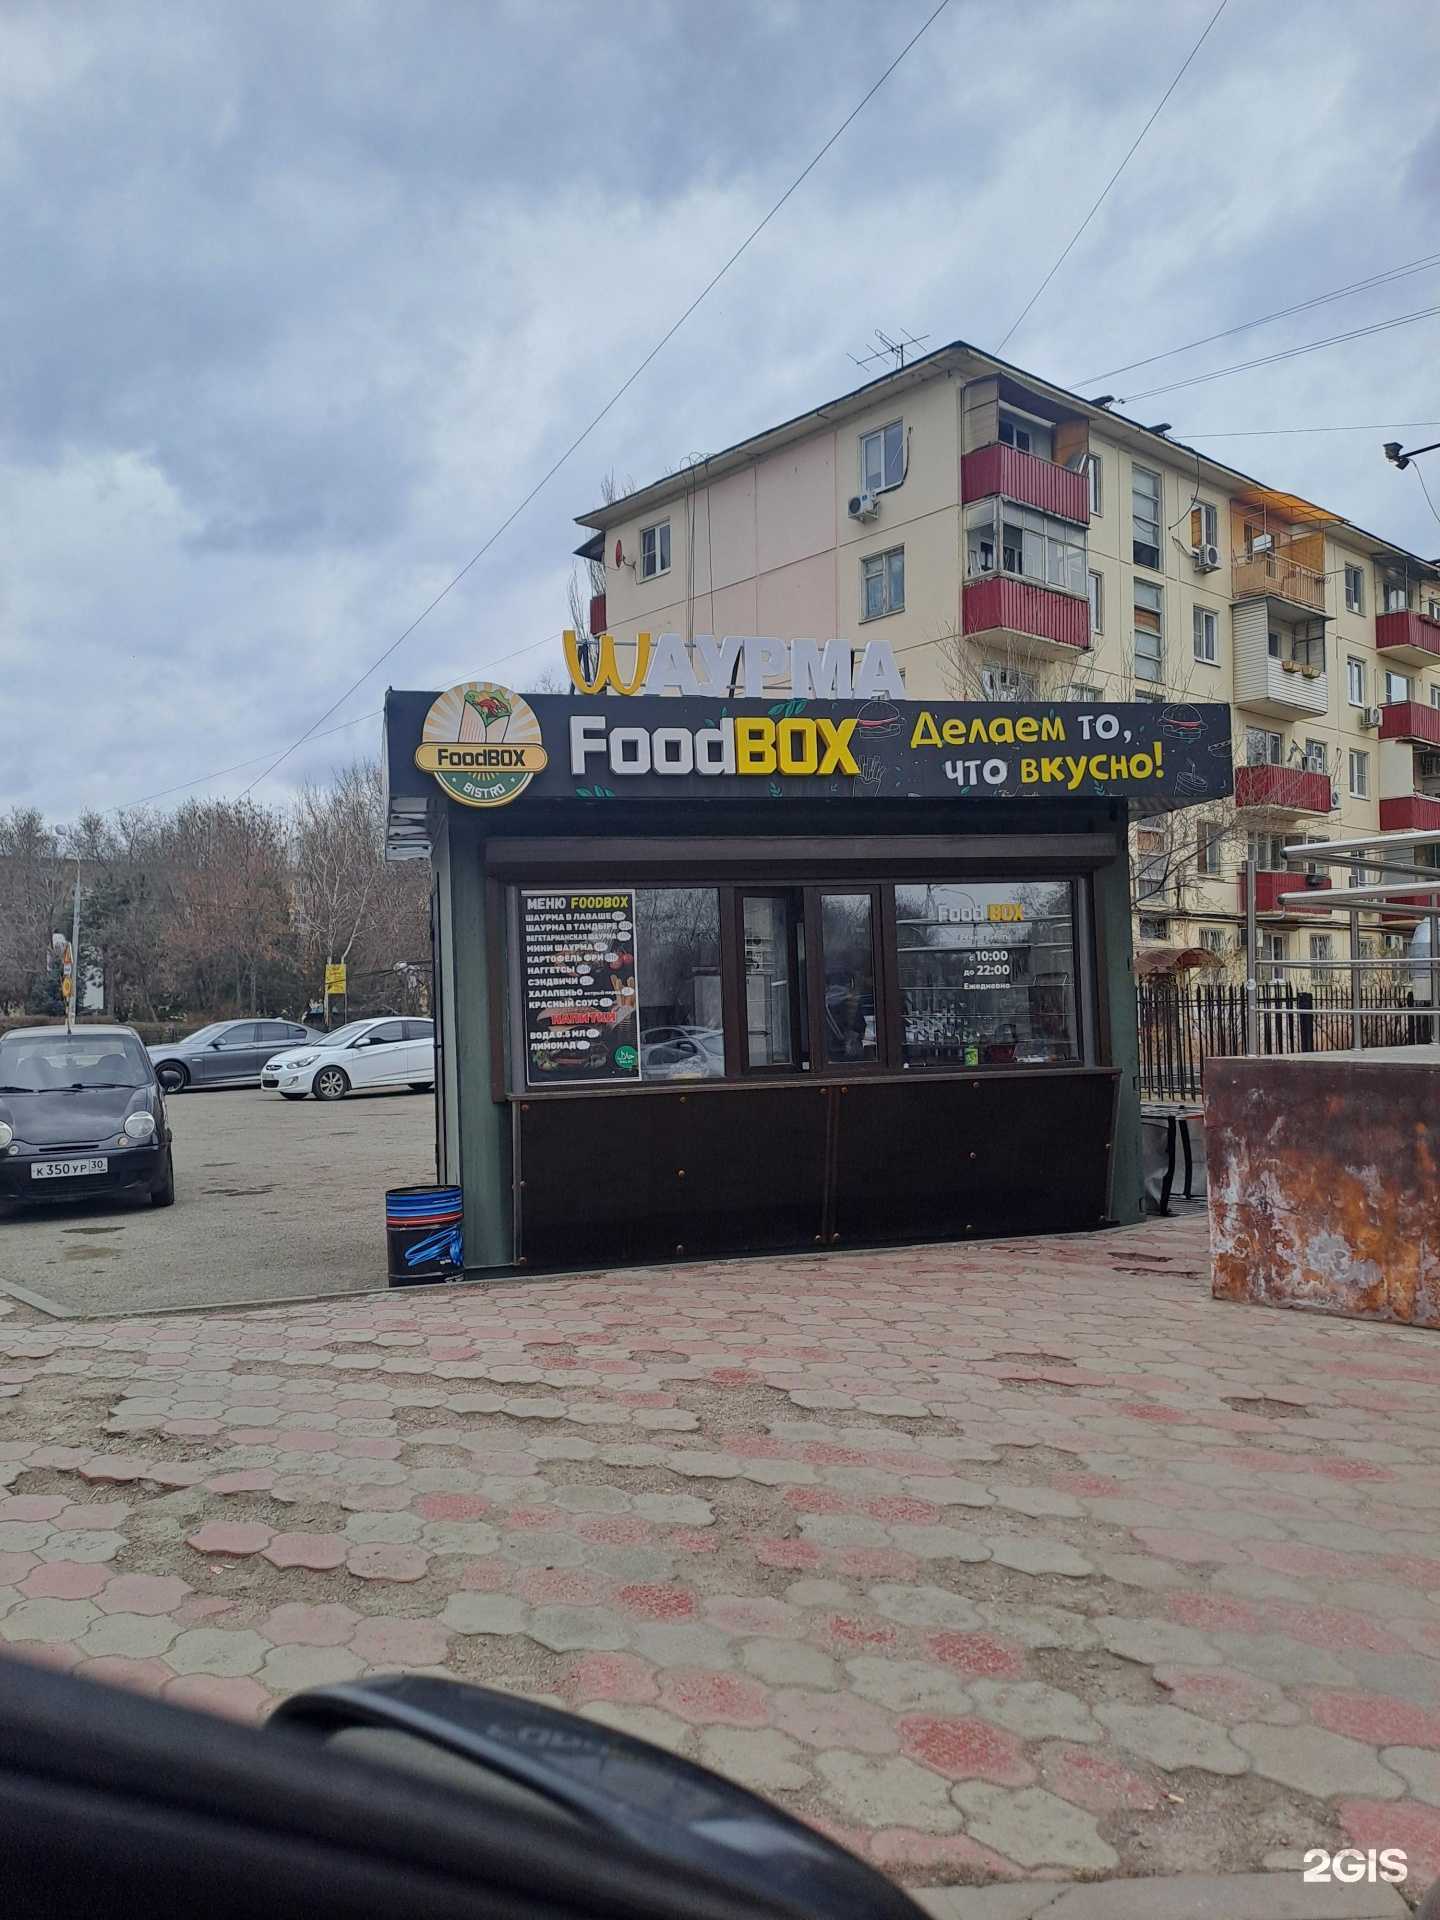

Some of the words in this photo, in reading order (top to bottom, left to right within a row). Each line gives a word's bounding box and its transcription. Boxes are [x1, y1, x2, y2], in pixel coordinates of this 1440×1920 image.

[910, 712, 1066, 748] Делаем
[1077, 713, 1133, 743] то,
[569, 715, 861, 776] FoodBOX
[437, 749, 526, 766] FoodBOX
[944, 758, 1008, 786] что
[1020, 741, 1165, 790] вкусно!
[463, 782, 506, 798] BISTRO
[527, 897, 567, 910] МЕНЮ
[570, 896, 628, 909] FOODBOX
[525, 914, 565, 922] ШАУРМА
[573, 912, 612, 920] ЛАВАШЕ
[525, 923, 565, 932] ШАУРМА
[565, 923, 572, 931] В
[526, 944, 553, 952] МИНИ
[554, 943, 593, 951] ШАУРМА
[527, 954, 582, 964] КАРТОФЕЛЬ
[975, 951, 1008, 961] 10:00
[527, 966, 575, 975] НАГГЕТСЫ
[976, 965, 1010, 976] 22:00
[527, 977, 578, 987] СЭНДВИЧИ
[528, 988, 583, 998] ХАЛАПЕНЬО
[528, 999, 575, 1009] КРАСНЫЙ
[575, 999, 599, 1008] СОУС
[530, 1031, 556, 1040] ВОДА
[530, 1041, 577, 1051] ЛИМОНАД
